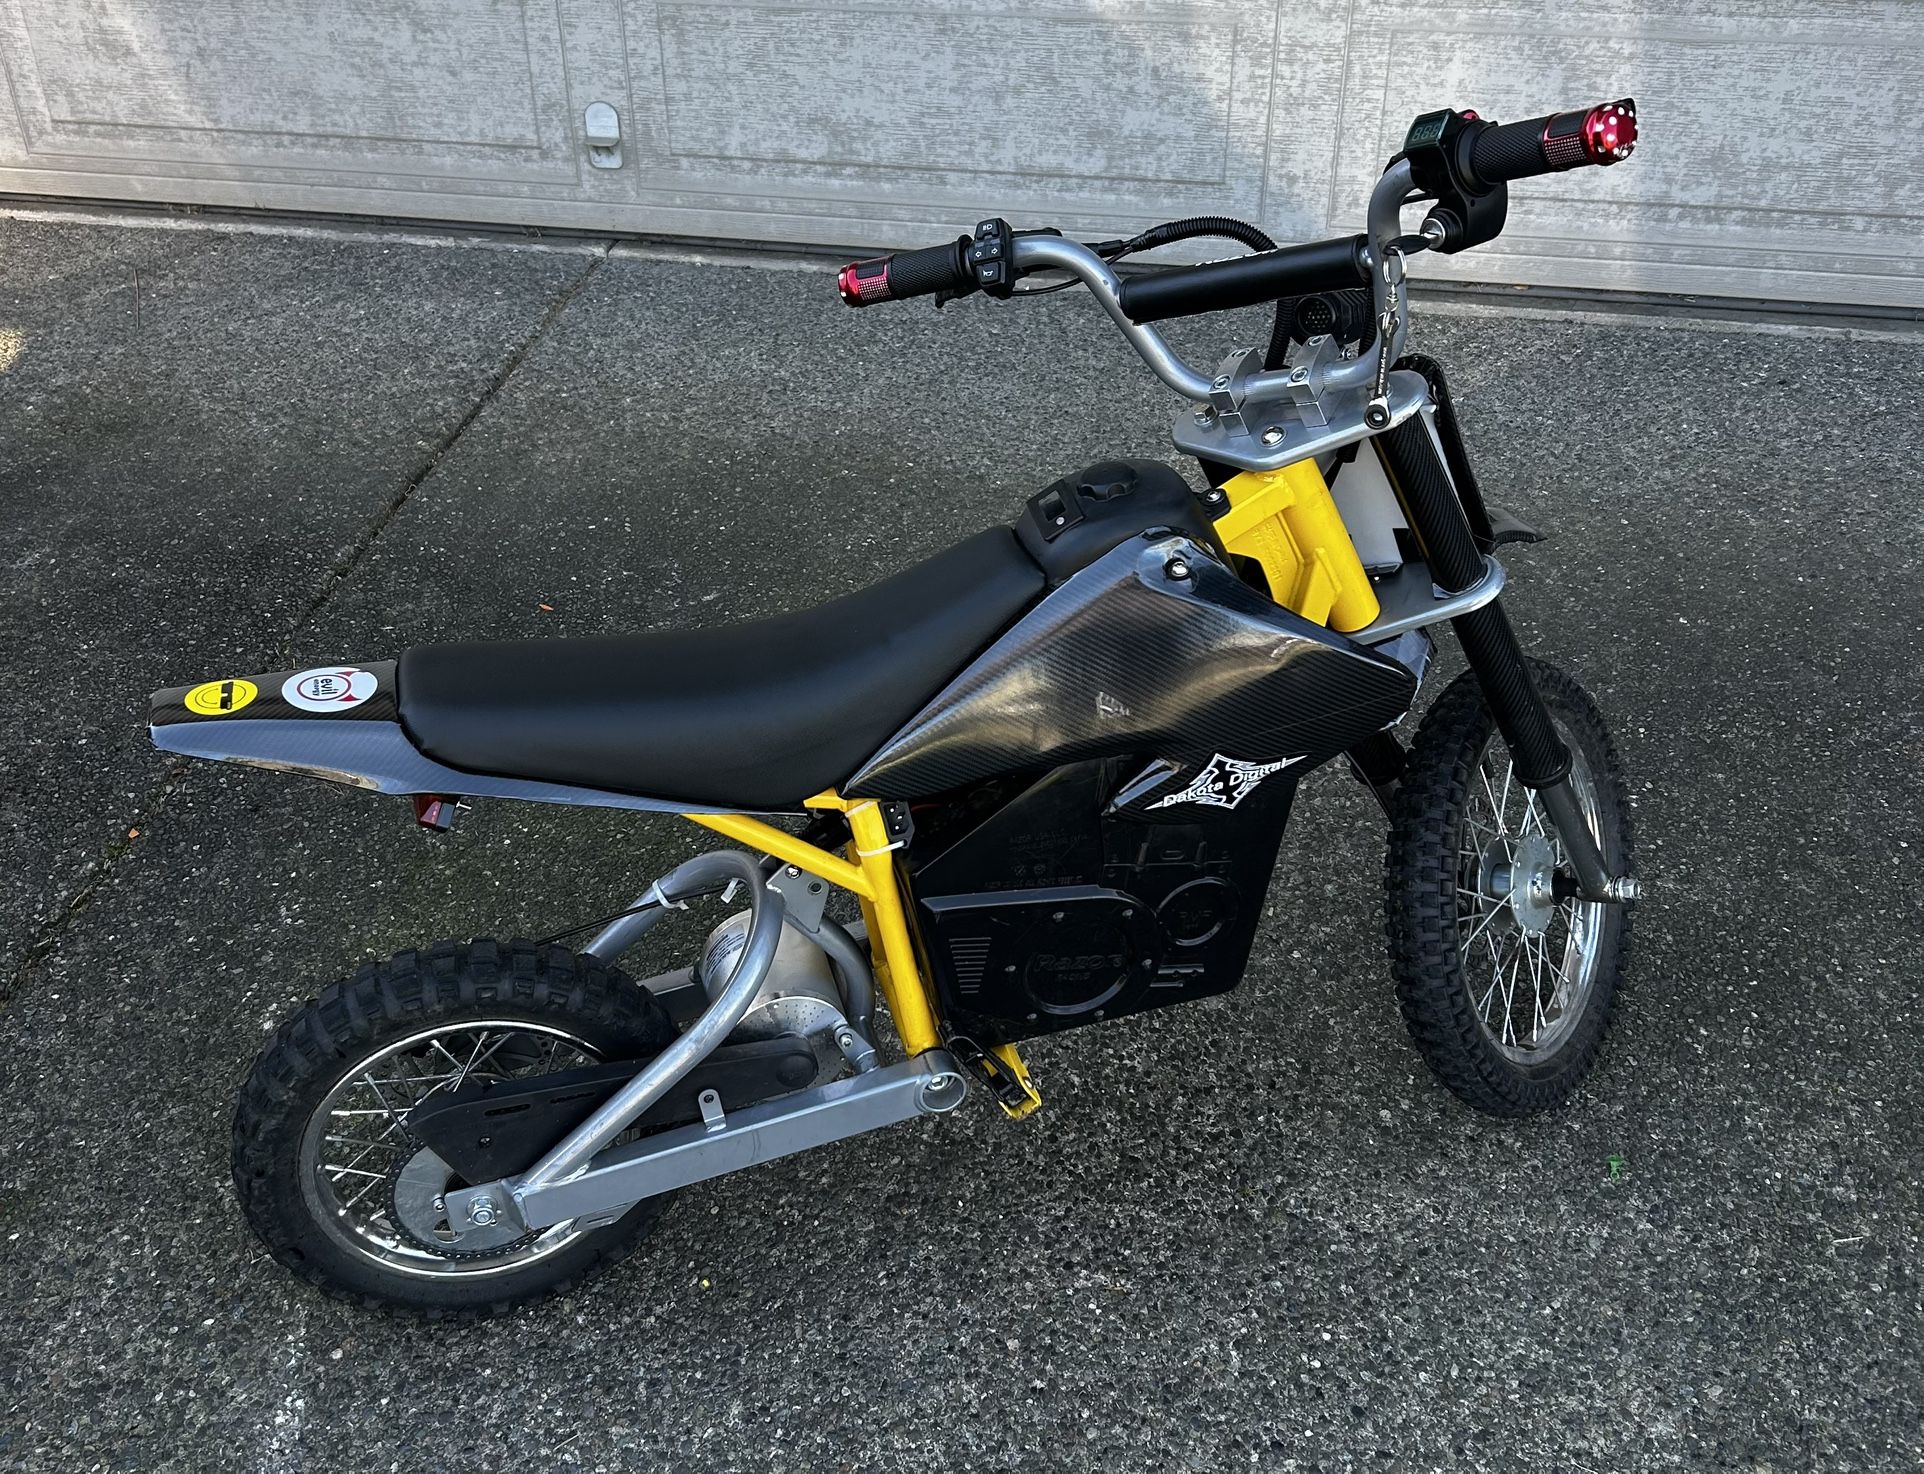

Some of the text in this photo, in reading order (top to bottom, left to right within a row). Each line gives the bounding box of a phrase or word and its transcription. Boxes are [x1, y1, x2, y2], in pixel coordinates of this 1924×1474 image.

[312, 679, 321, 697] energy
[320, 679, 338, 695] evil
[1163, 757, 1286, 807] Dakota Digital
